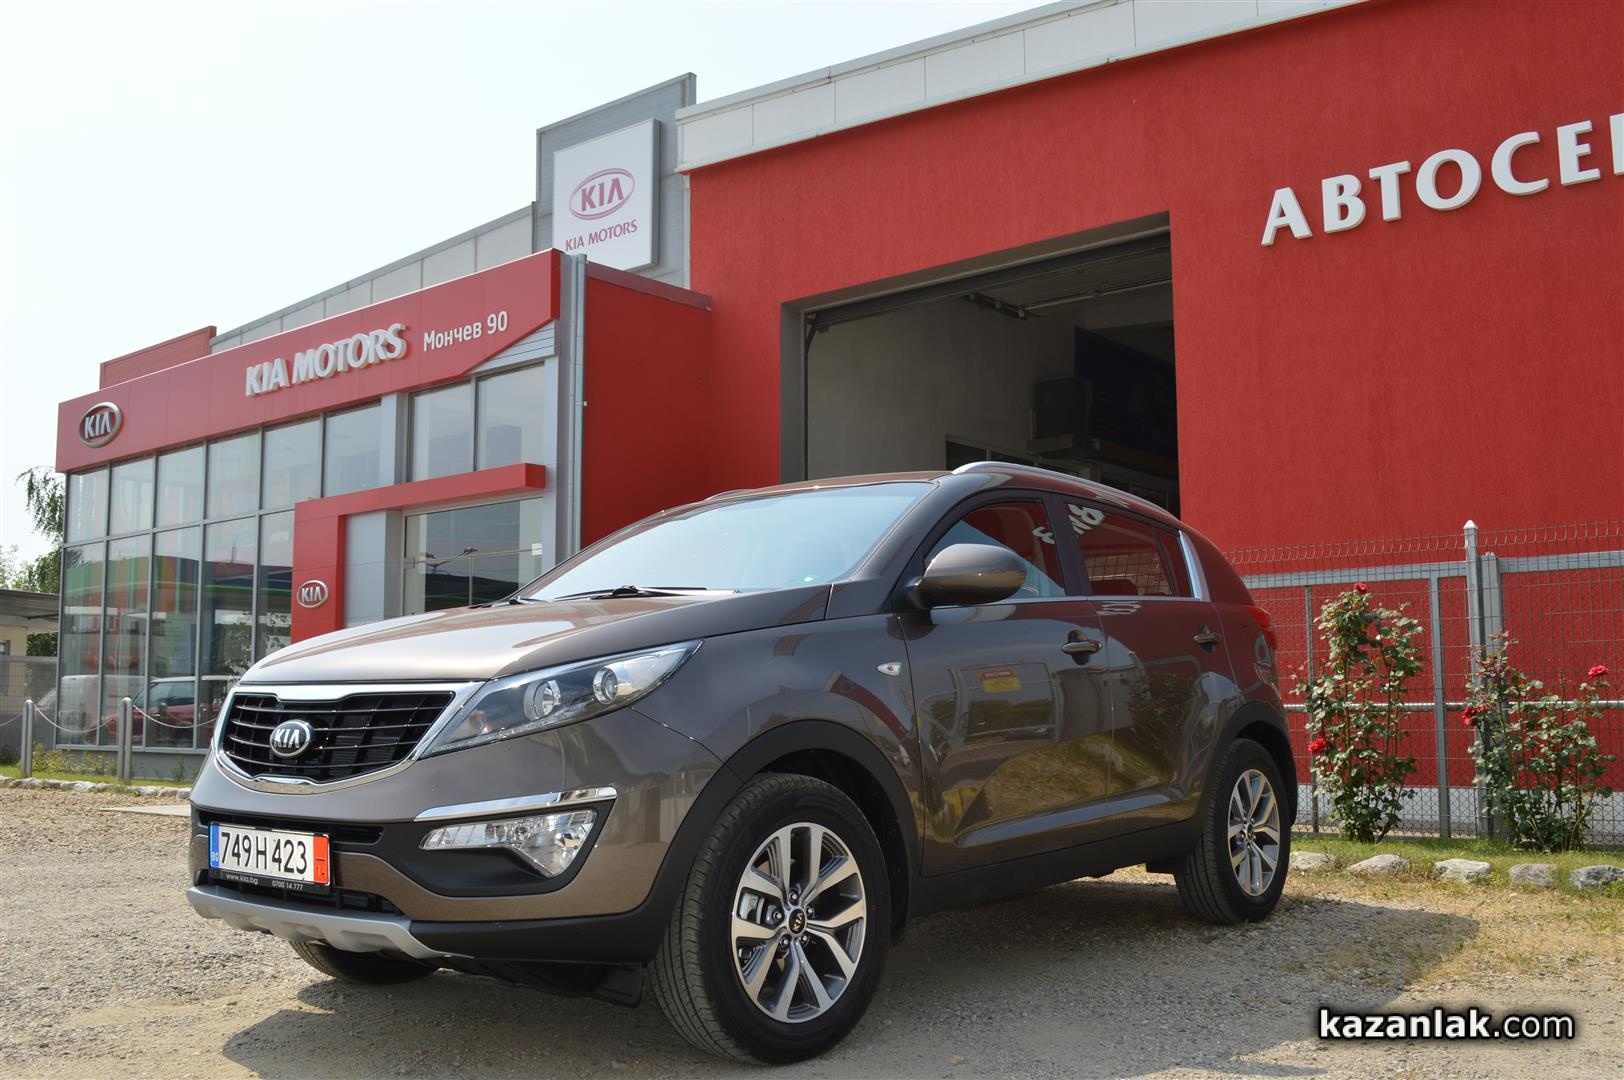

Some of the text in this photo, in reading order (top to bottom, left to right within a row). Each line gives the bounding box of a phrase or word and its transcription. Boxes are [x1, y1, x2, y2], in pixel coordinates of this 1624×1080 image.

[581, 177, 624, 212] KIA
[565, 219, 638, 251] KIA MOTORS
[423, 310, 508, 351] Мончев 90
[245, 323, 407, 397] KIA MOTORS
[84, 411, 112, 439] KIA
[301, 586, 322, 603] KIA
[274, 728, 300, 748] KIA
